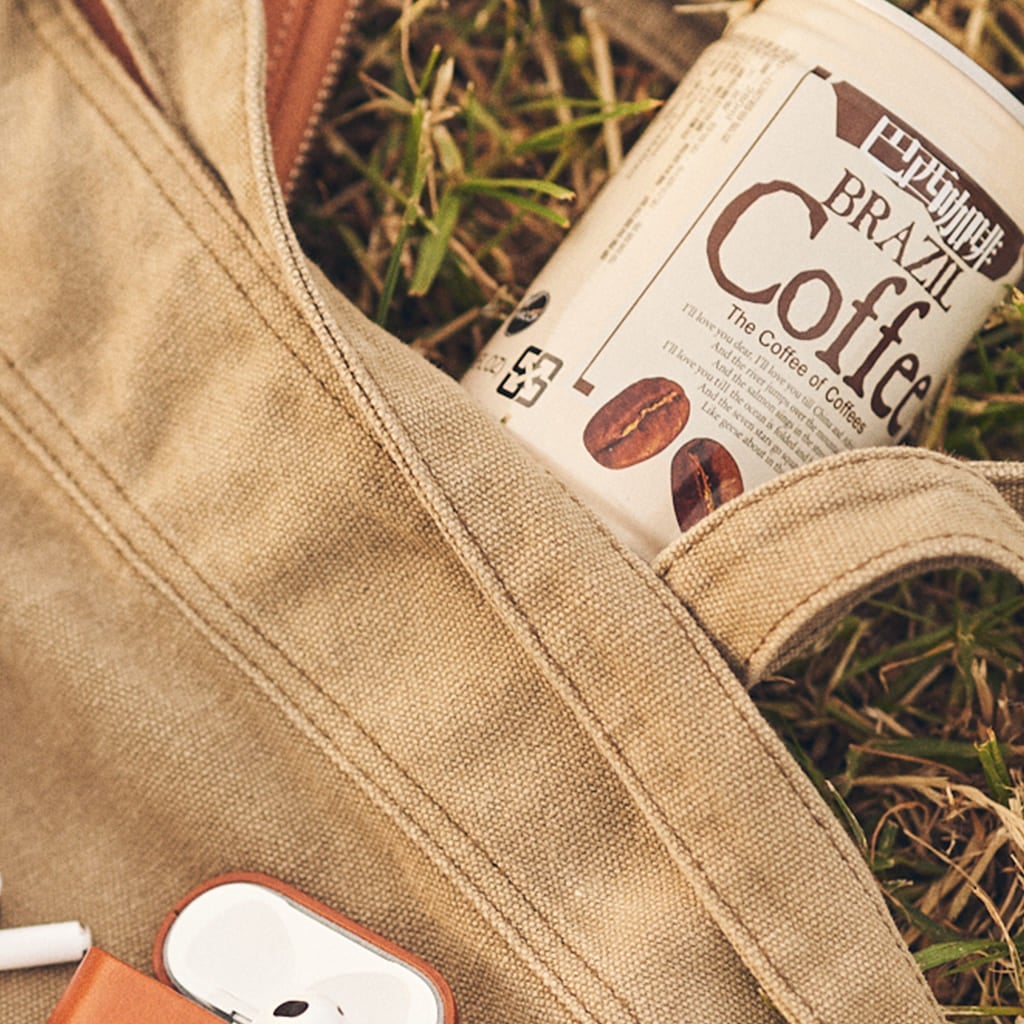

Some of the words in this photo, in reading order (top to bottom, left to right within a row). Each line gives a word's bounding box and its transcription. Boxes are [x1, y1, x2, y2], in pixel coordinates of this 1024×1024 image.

[821, 167, 964, 313] BRAZIL
[706, 179, 932, 437] Coffee
[696, 311, 717, 332] love
[714, 328, 735, 345] you
[711, 341, 733, 359] And
[731, 356, 747, 370] the
[726, 304, 756, 335] The
[758, 329, 809, 376] Coffee
[808, 374, 828, 391] of
[824, 386, 868, 435] Coffees
[676, 348, 697, 369] love
[694, 365, 714, 382] you
[729, 389, 745, 405] the
[712, 359, 734, 378] And
[732, 374, 747, 389] the
[697, 383, 720, 401] And
[717, 397, 733, 412] the
[701, 400, 721, 421] Like
